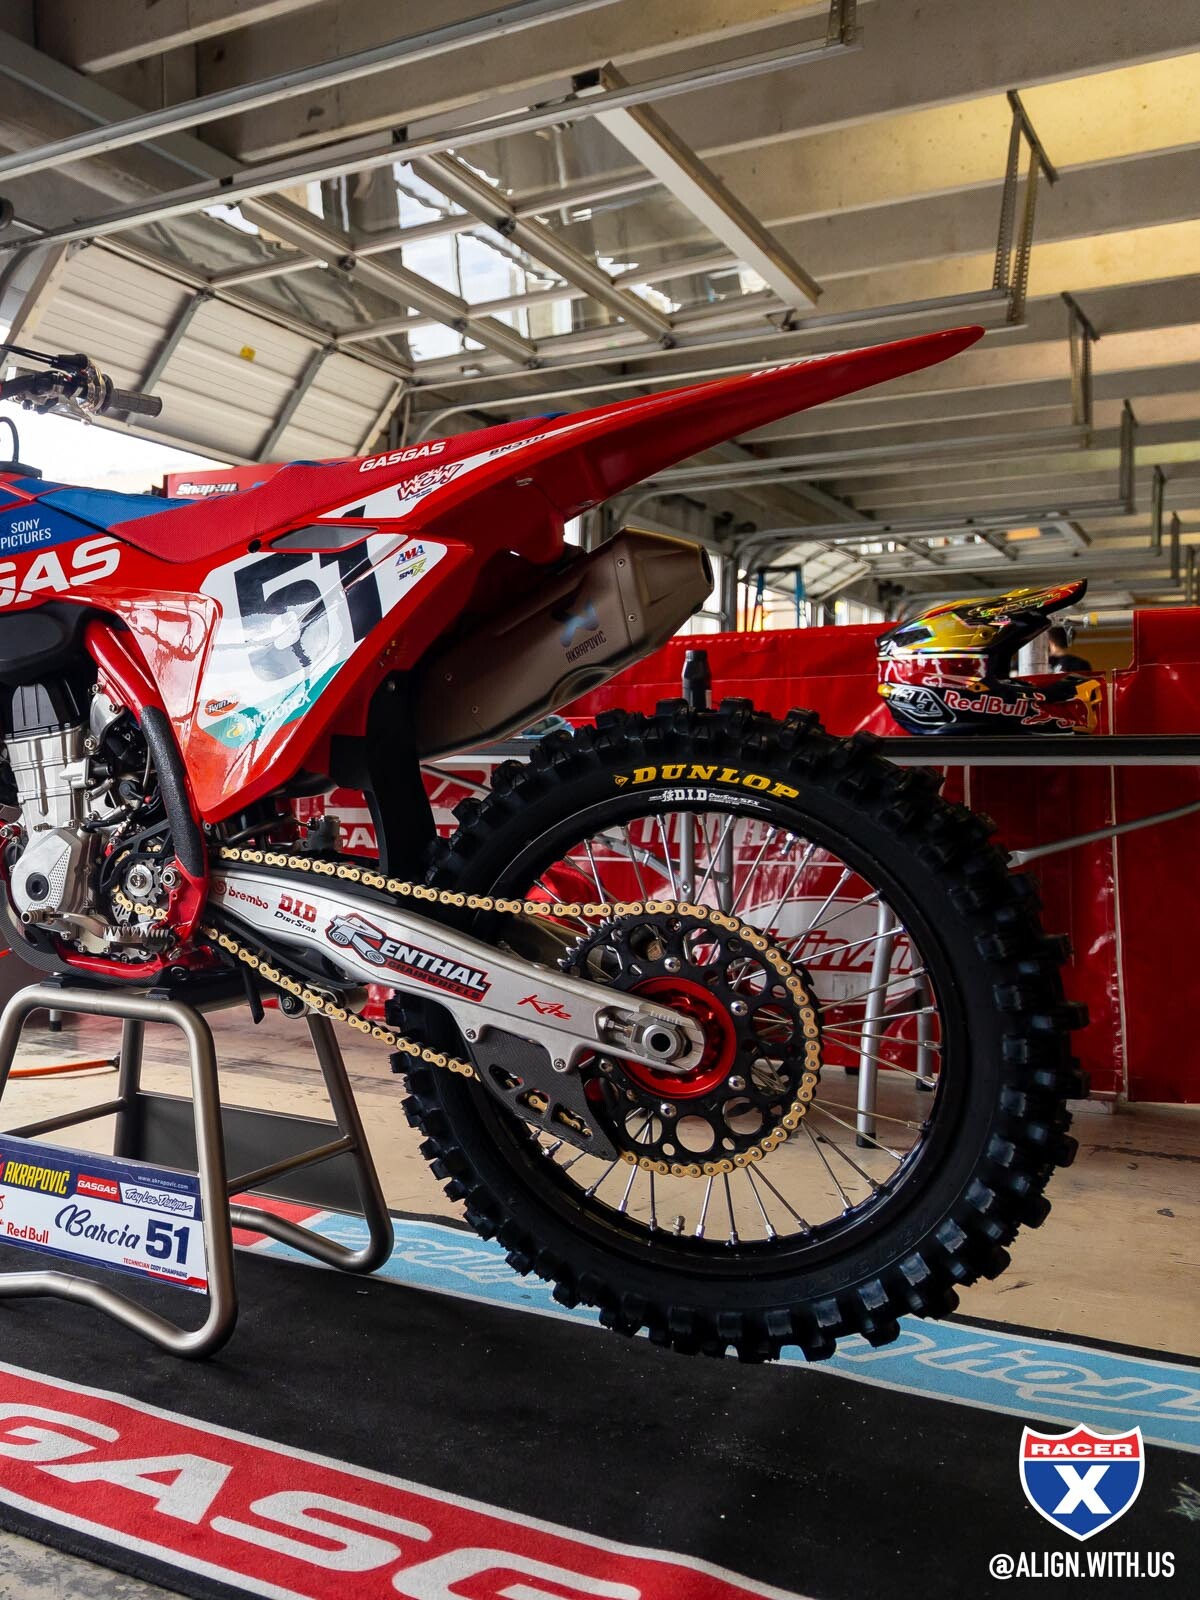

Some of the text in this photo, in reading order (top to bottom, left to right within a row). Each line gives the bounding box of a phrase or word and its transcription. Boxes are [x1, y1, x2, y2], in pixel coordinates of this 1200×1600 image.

[359, 441, 446, 473] GASGAS
[0, 527, 52, 550] PICTURES
[10, 518, 40, 534] SONY
[396, 544, 426, 567] AMA
[234, 505, 383, 682] 51
[944, 690, 1029, 717] Red Bull
[631, 763, 801, 800] DUNLOP
[228, 885, 269, 910] brembo
[278, 893, 317, 923] D.I.D
[387, 960, 482, 1000] CHAINWHEELS
[77, 1179, 118, 1195] GASGAS
[158, 1194, 194, 1212] Designs
[7, 1221, 49, 1244] Red Bull
[54, 1204, 190, 1265] Barcia 51
[123, 1257, 150, 1270] TECHNICIAN
